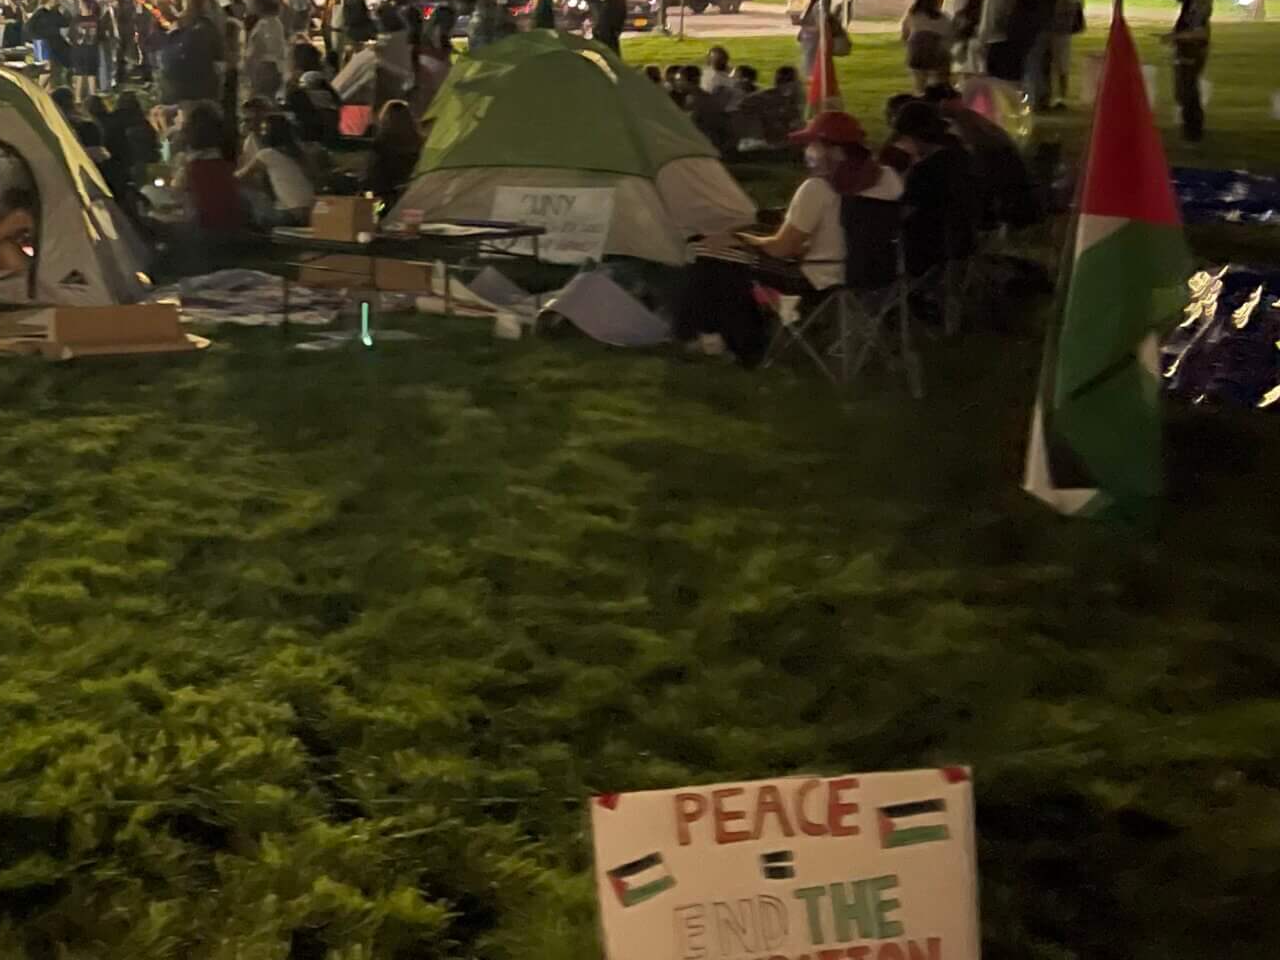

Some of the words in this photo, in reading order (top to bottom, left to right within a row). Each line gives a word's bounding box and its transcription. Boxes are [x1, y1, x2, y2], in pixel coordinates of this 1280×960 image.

[674, 778, 860, 846] PEACE
[673, 894, 790, 960] END
[793, 874, 905, 946] THE
